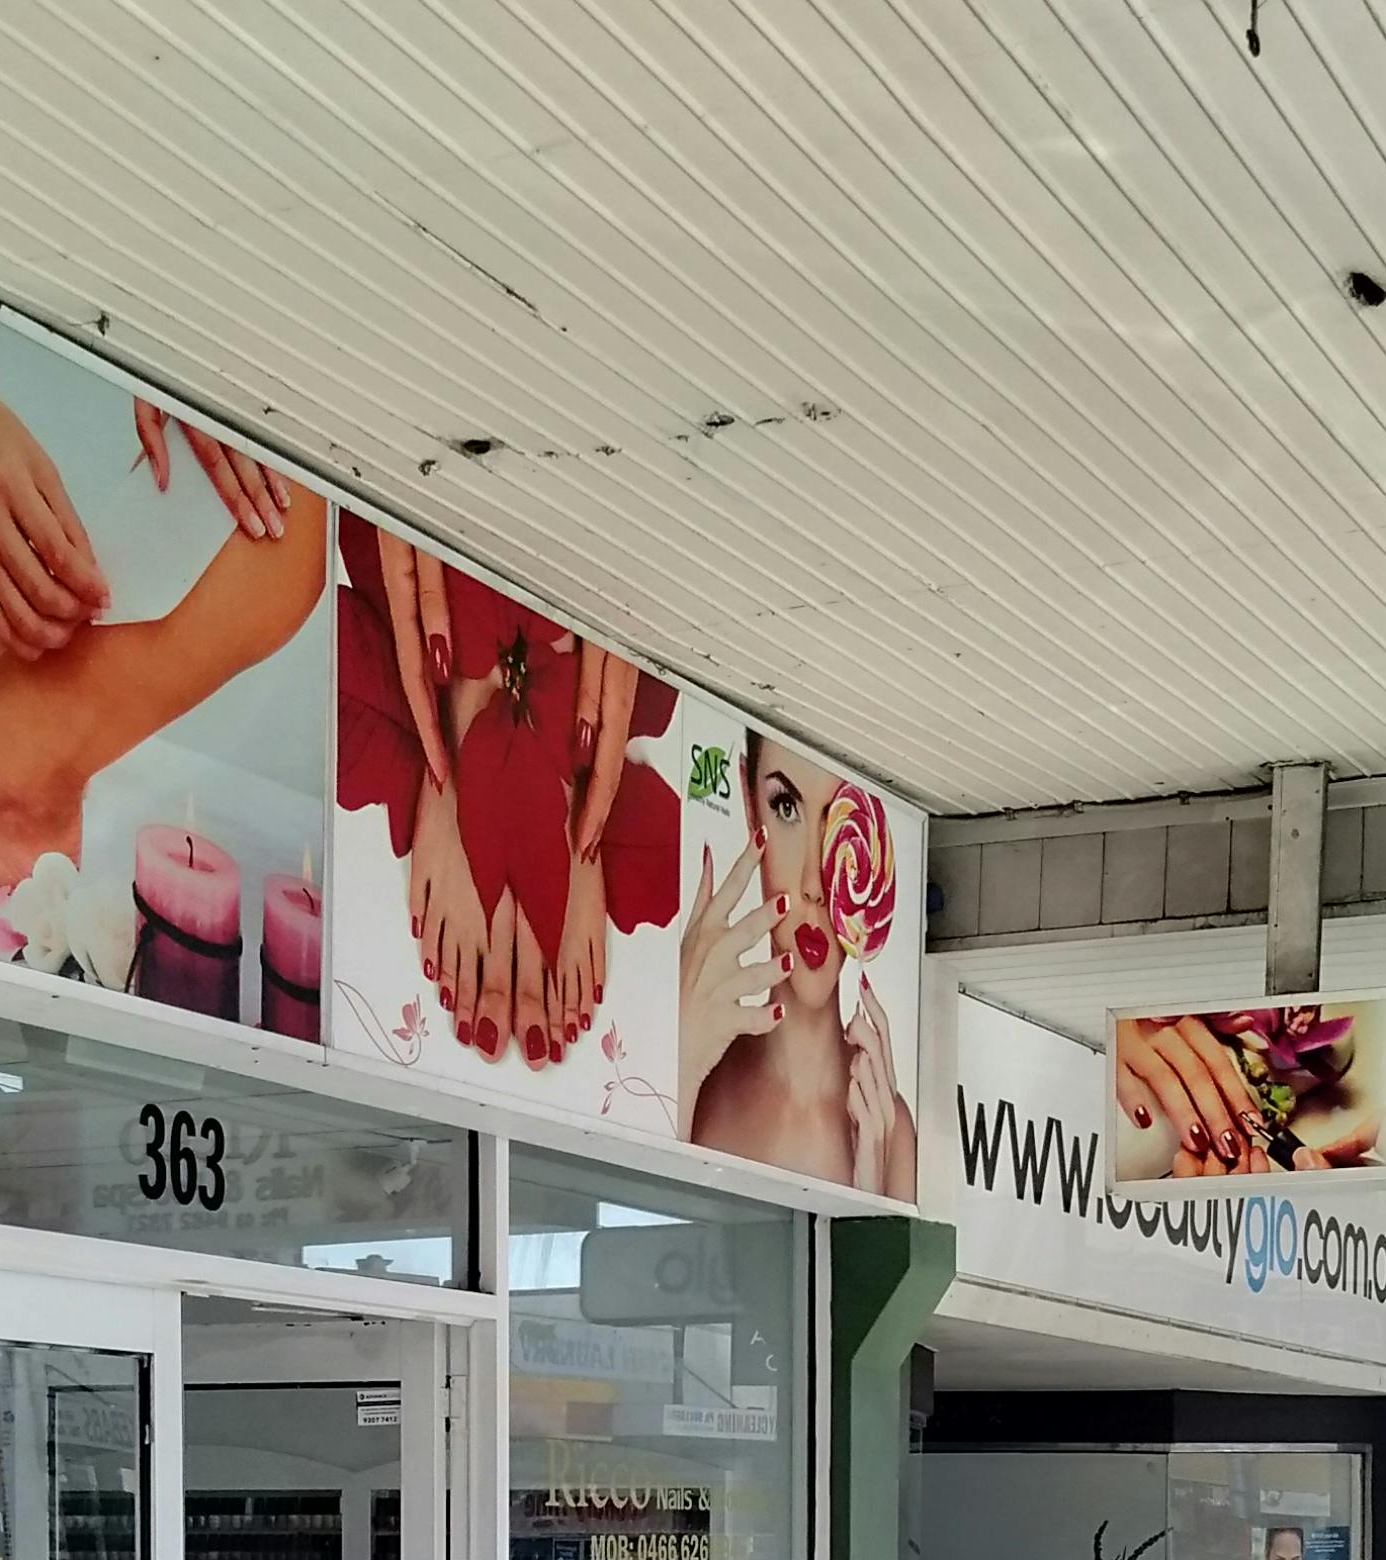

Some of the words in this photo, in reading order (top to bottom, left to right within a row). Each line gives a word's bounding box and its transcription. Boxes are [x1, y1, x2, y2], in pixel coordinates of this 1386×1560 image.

[690, 744, 731, 799] SNS
[138, 1103, 226, 1211] 363
[657, 1483, 693, 1511] Nails
